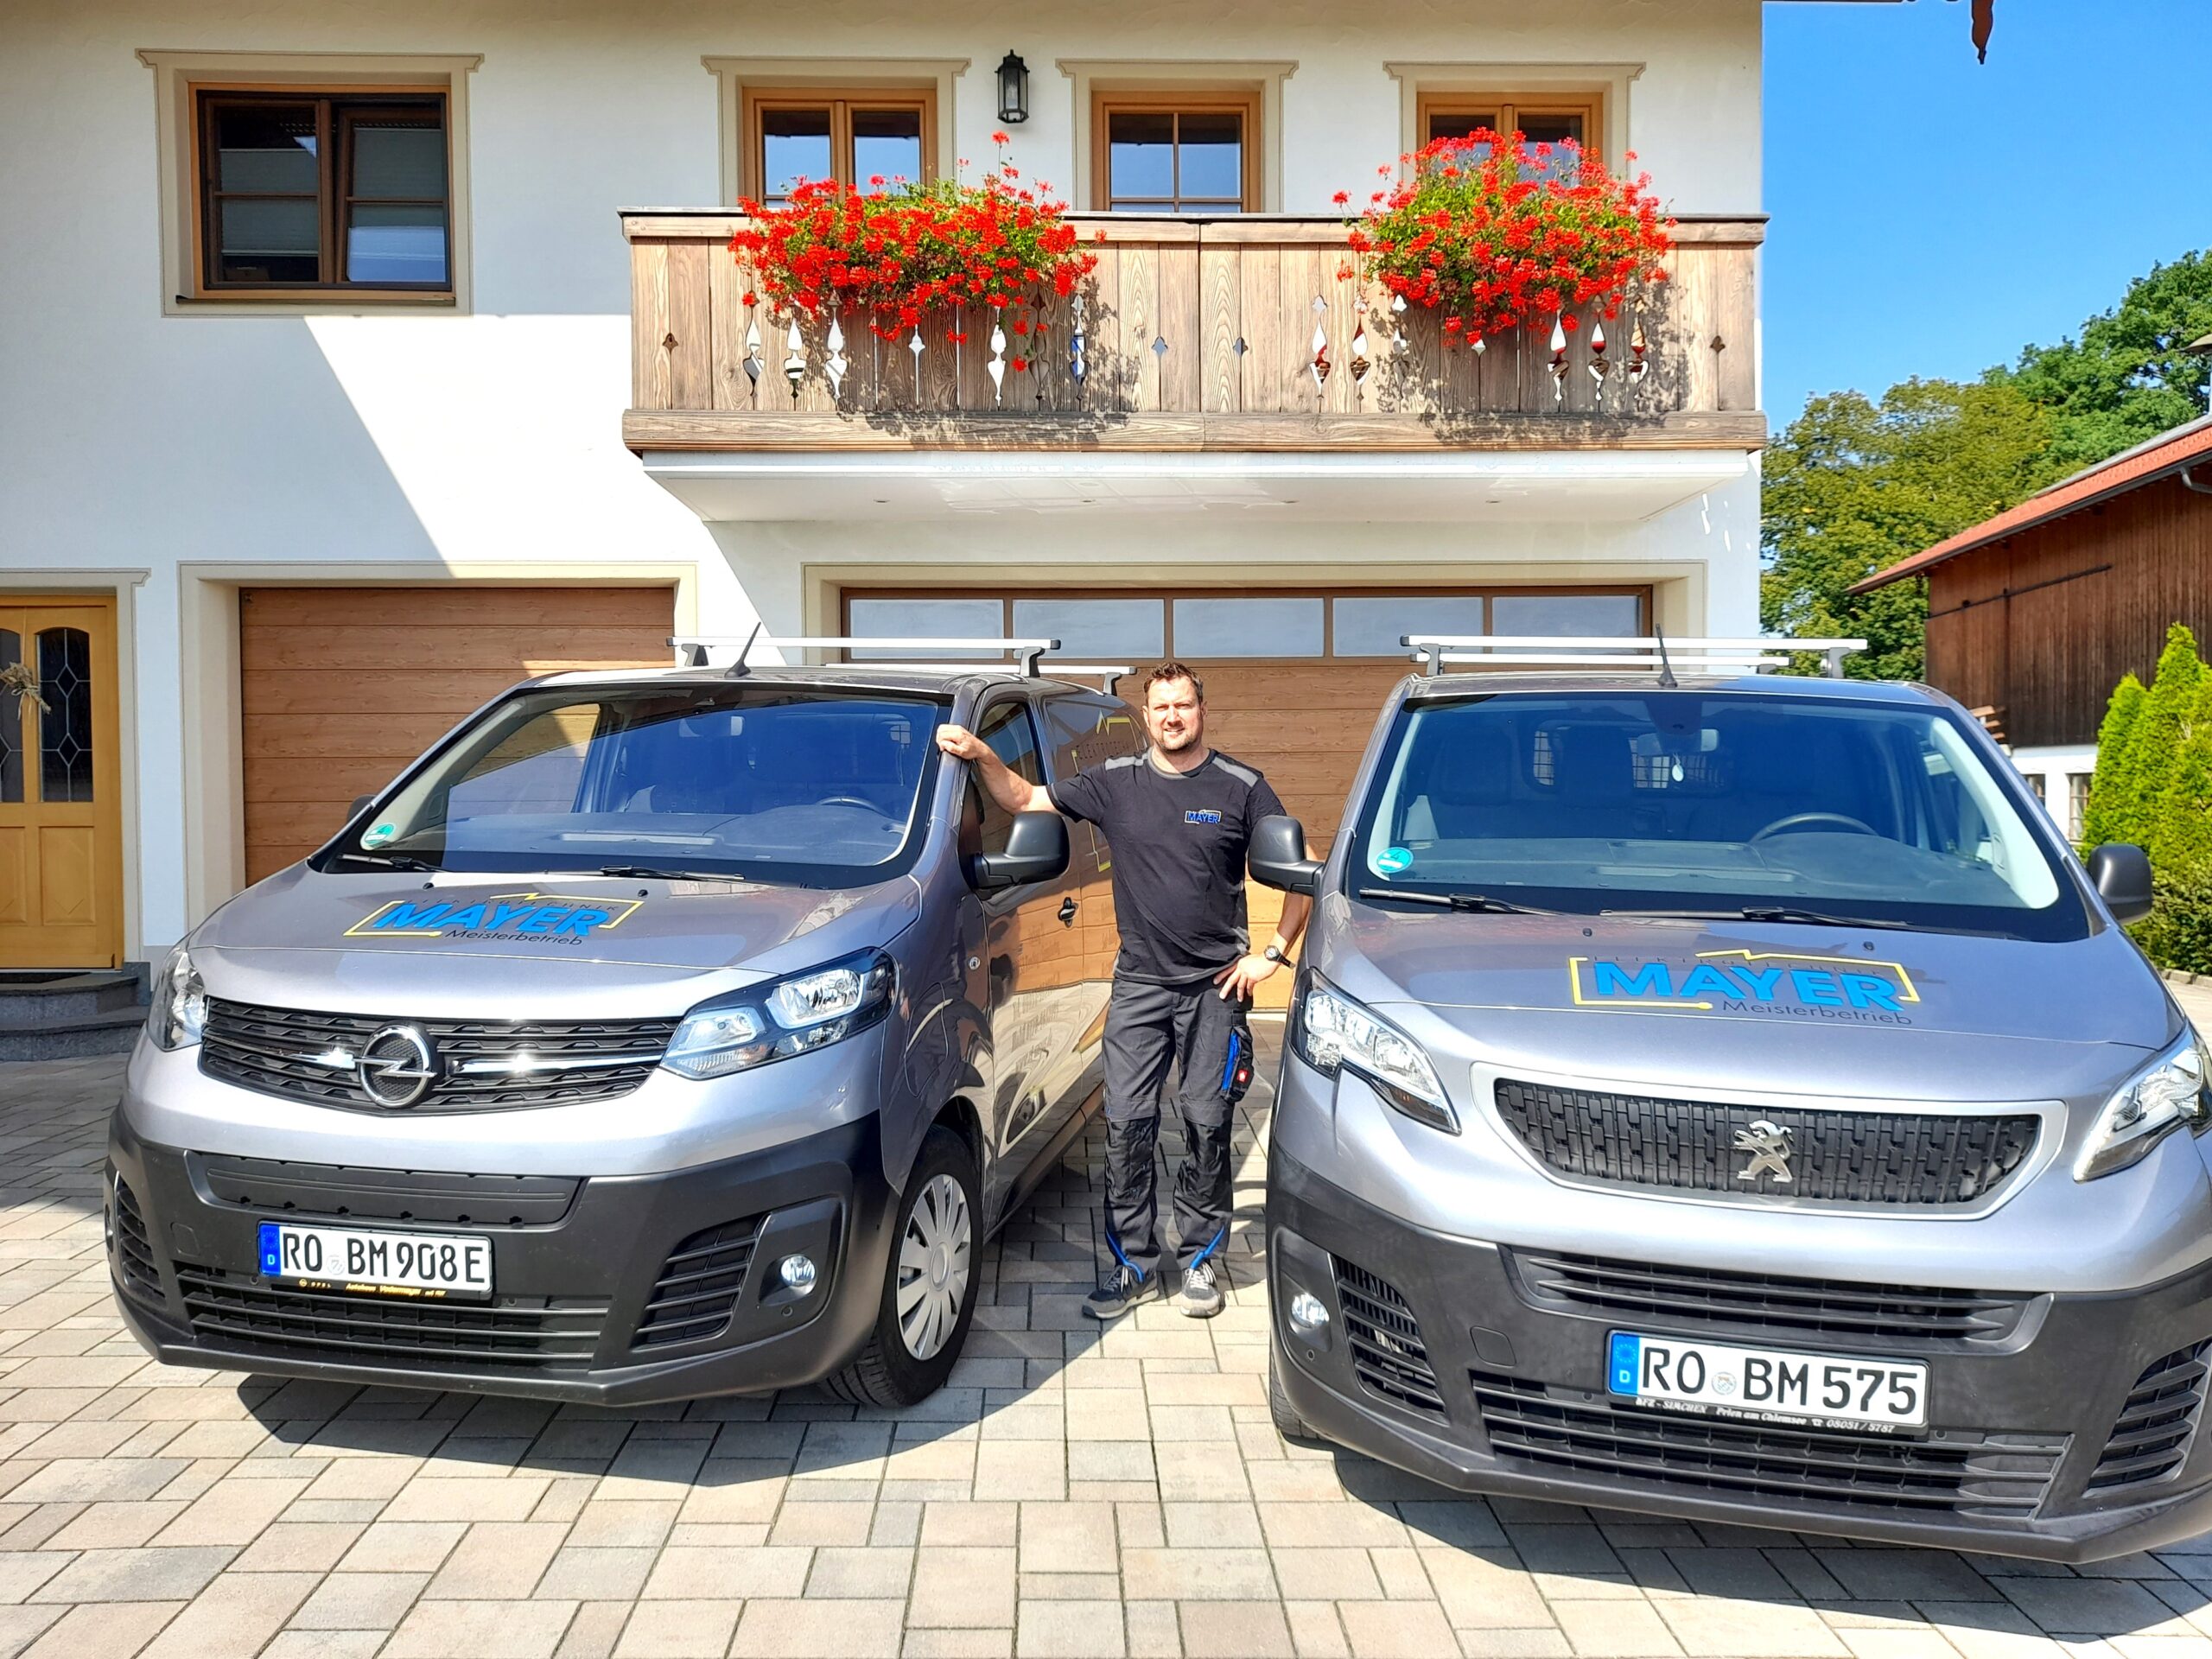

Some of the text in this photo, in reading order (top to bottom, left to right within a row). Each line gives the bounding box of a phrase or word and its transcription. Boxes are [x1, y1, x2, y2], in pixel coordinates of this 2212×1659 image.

[1188, 812, 1218, 823] MAYER
[372, 904, 609, 937] MAYER
[445, 929, 583, 946] Meisterbetrieb
[1593, 962, 1905, 1012] MAYER
[1722, 1001, 1912, 1026] Meisterbetrieb
[267, 1255, 276, 1265] D
[283, 1233, 322, 1272] RO
[1618, 1370, 1629, 1383] D
[1643, 1346, 1918, 1415] RO BM 575
[1716, 1407, 1742, 1418] Prien
[1744, 1411, 1760, 1420] am
[1761, 1412, 1808, 1425] Chiemsee
